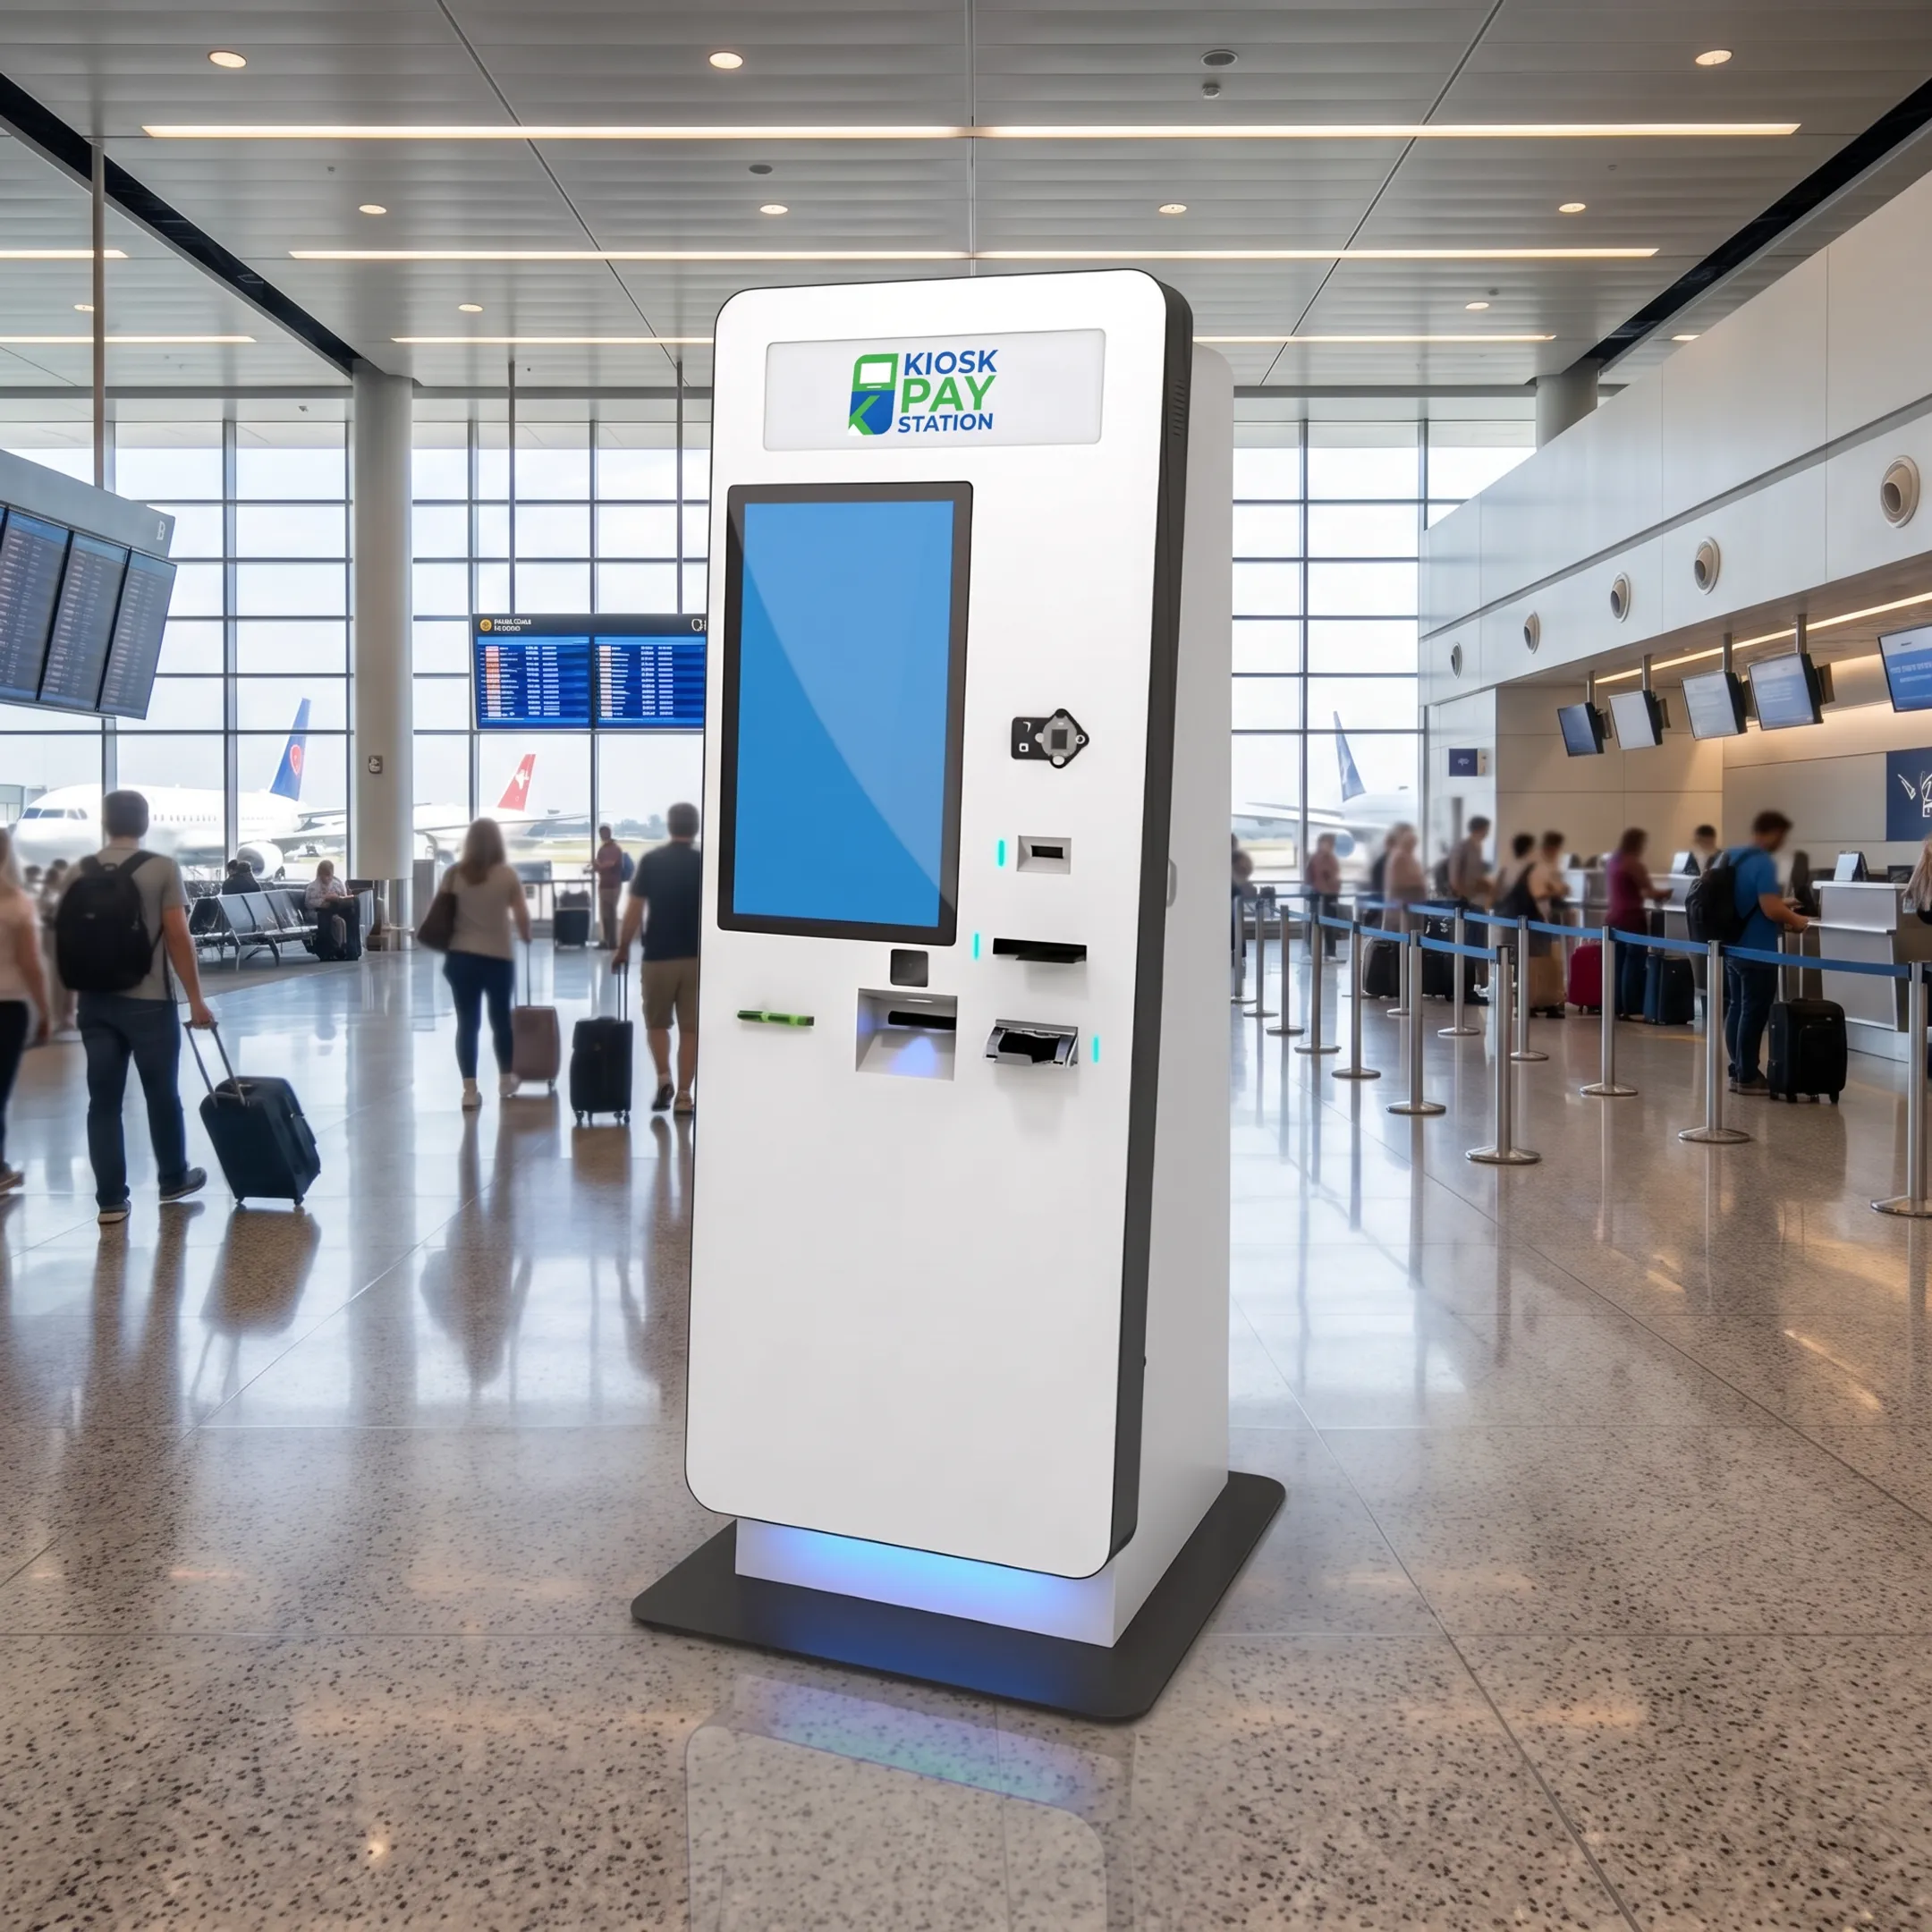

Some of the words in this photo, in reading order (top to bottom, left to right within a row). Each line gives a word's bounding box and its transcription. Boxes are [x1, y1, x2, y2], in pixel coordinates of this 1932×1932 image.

[903, 349, 998, 376] KIOSK
[901, 375, 996, 413] PAY
[897, 412, 994, 433] STATION
